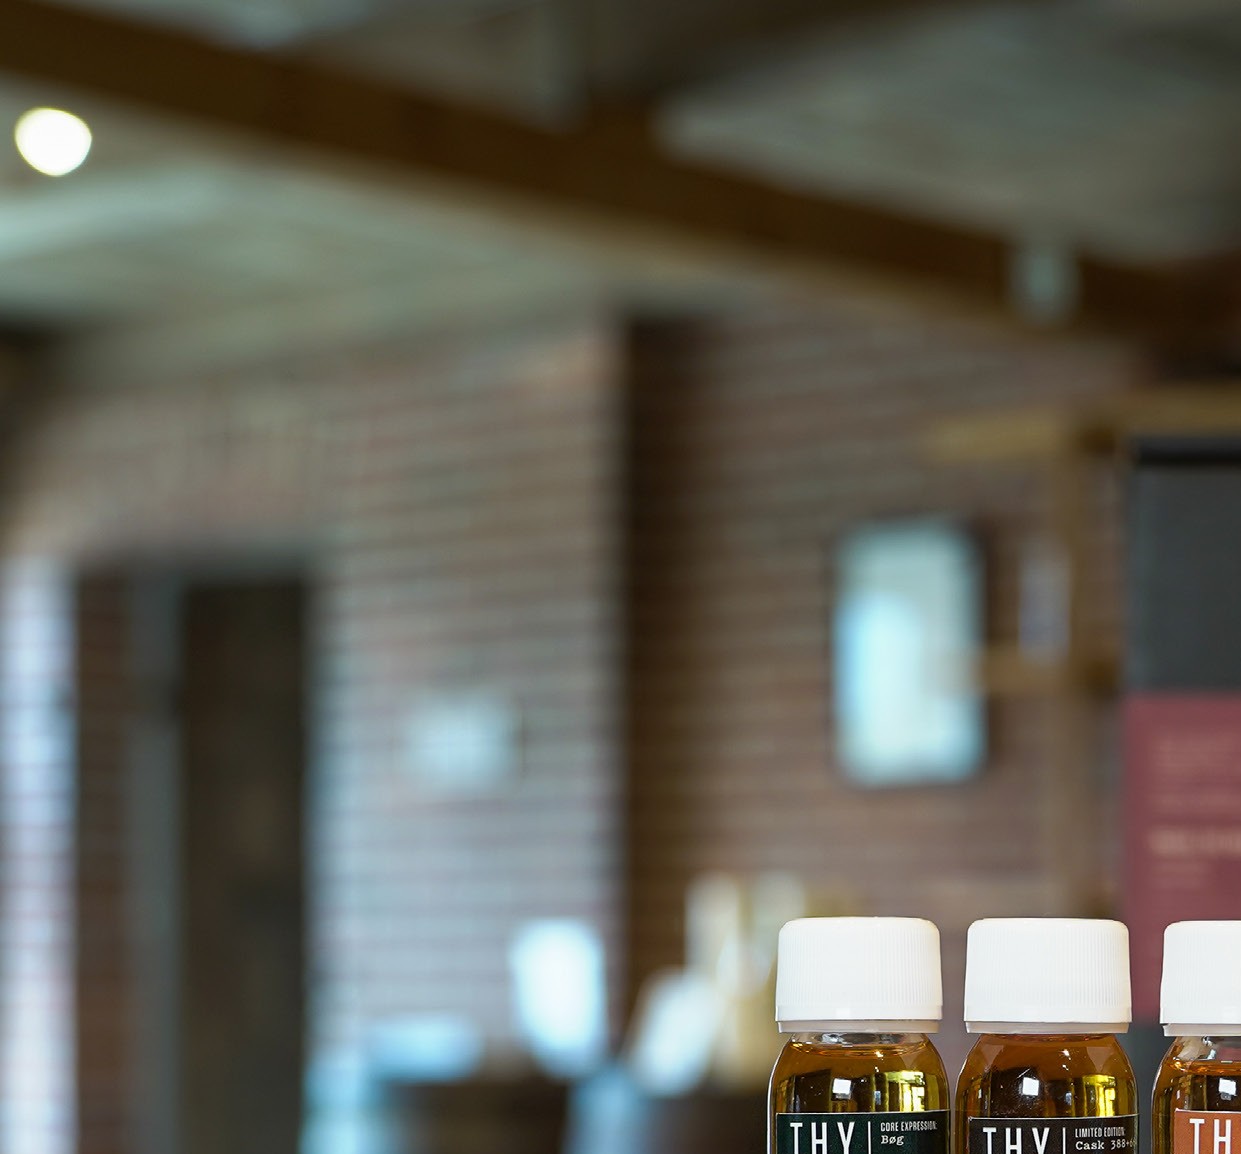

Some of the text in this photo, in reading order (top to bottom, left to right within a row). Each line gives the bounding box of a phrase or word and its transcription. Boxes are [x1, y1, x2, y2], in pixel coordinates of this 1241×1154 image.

[880, 1122, 899, 1132] CORE
[1075, 1127, 1103, 1138] LIMITED
[881, 1135, 904, 1146] Bøg
[1075, 1140, 1105, 1151] Cask
